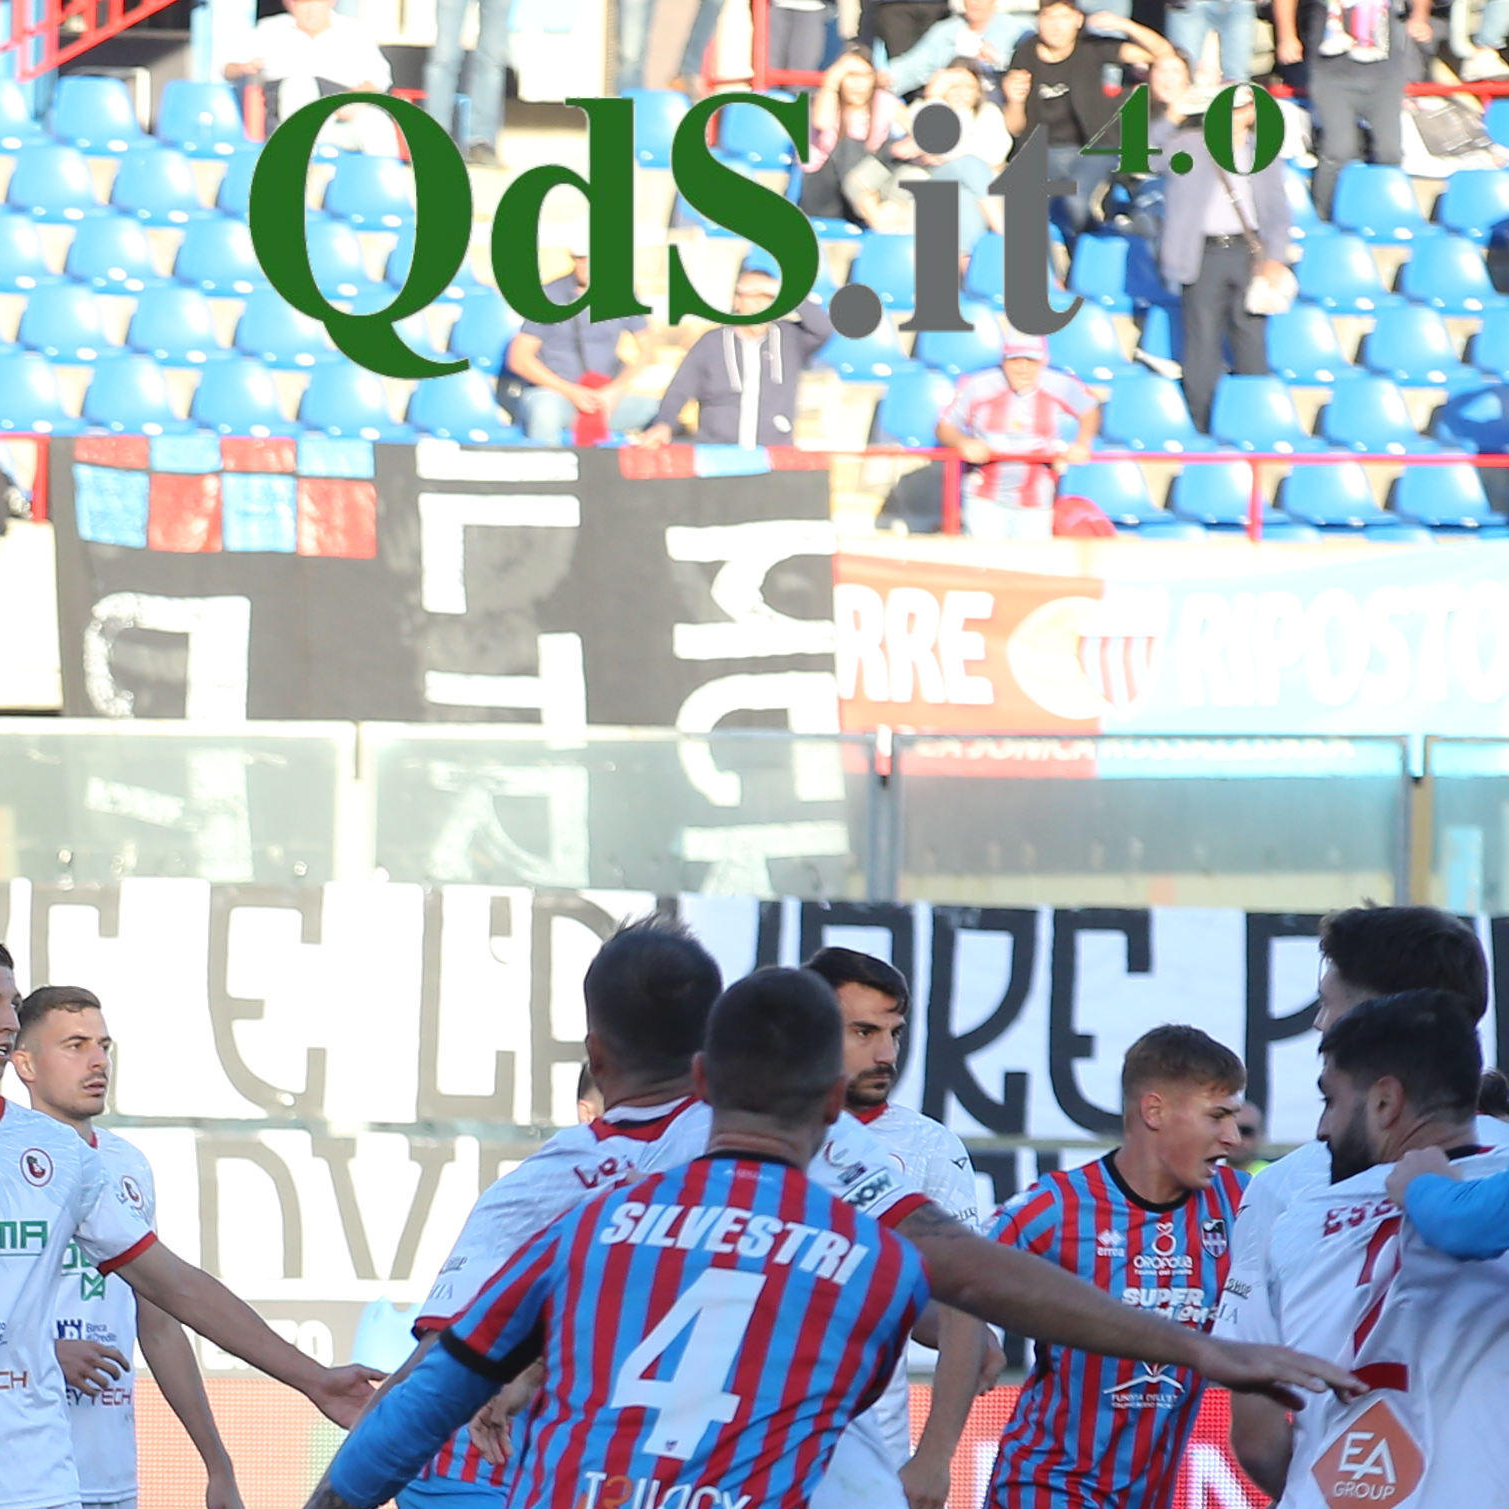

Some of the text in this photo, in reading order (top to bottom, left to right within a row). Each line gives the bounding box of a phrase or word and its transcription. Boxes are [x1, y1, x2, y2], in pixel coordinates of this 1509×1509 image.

[1178, 582, 1509, 708] RIPOSTO
[599, 1201, 869, 1286] SILVESTRI
[1121, 1287, 1205, 1308] SUPER
[609, 1266, 768, 1461] 4
[66, 1387, 132, 1407] EYTECH
[1337, 1431, 1398, 1484] EA
[1333, 1480, 1396, 1500] GROUP
